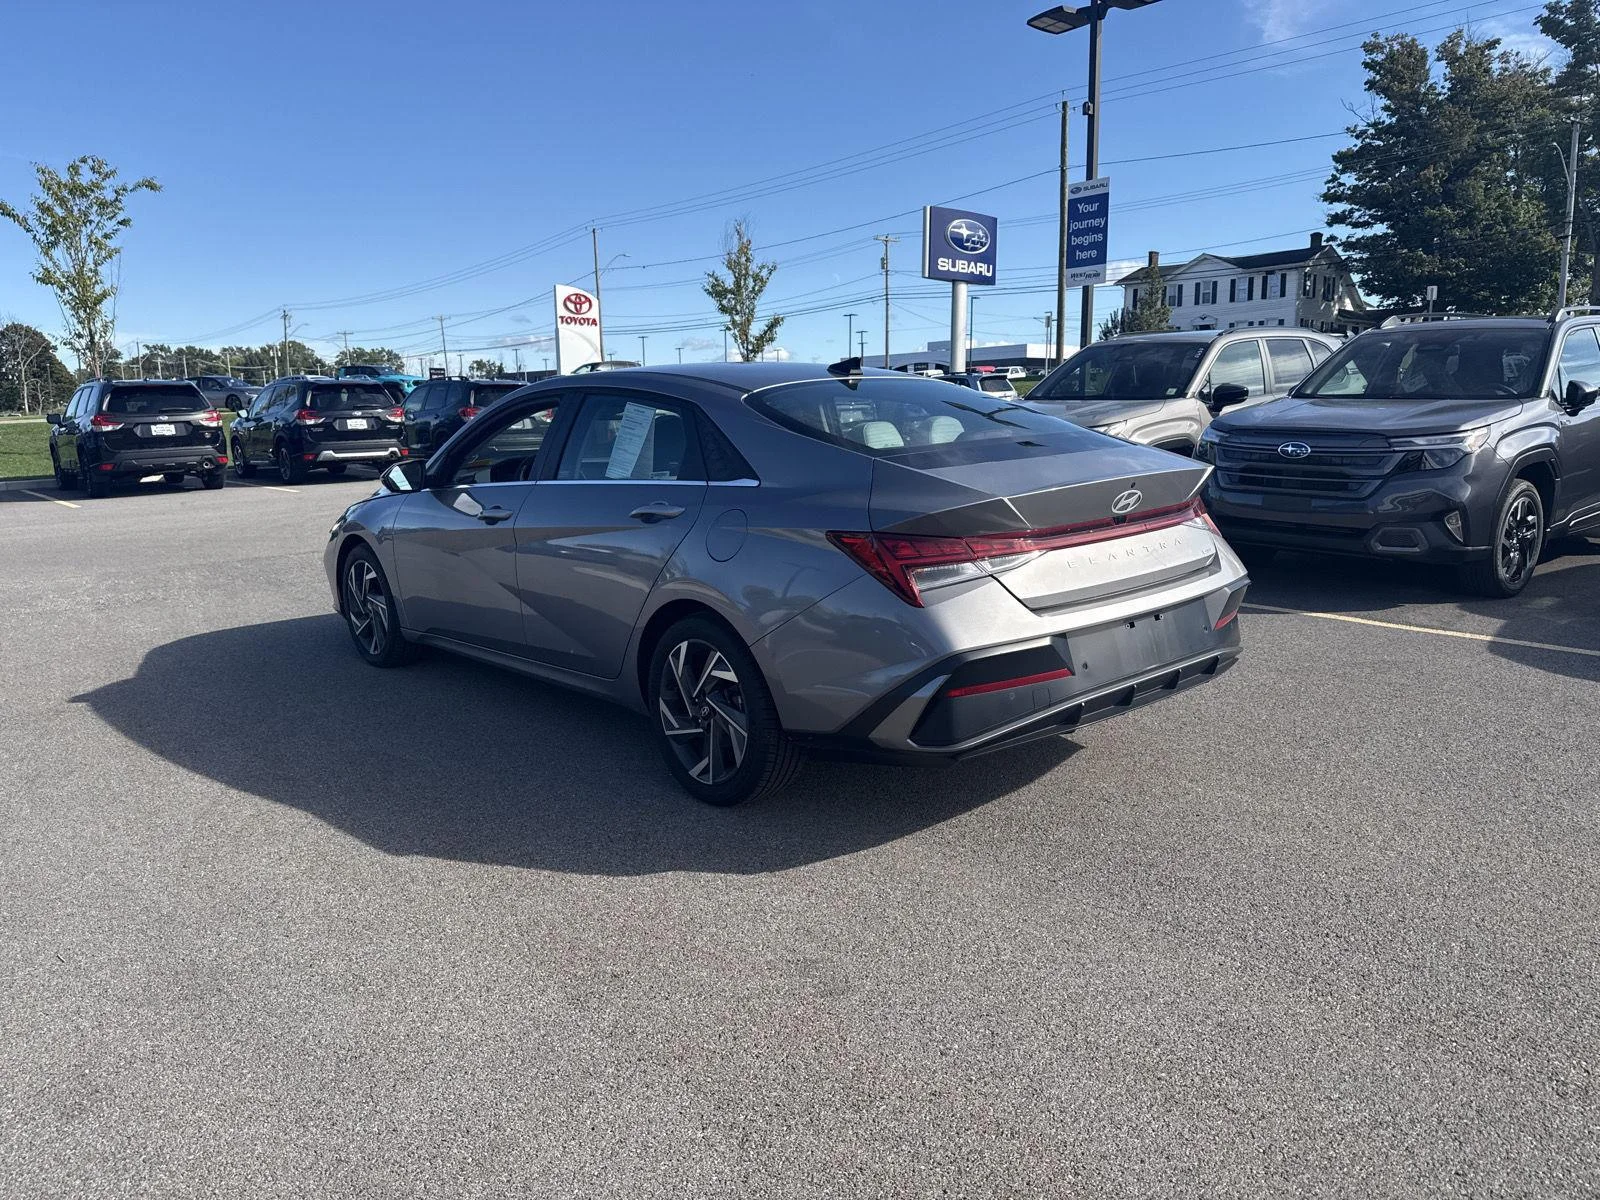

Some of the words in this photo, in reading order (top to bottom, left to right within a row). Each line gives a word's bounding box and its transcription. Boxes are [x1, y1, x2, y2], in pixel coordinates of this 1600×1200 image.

[1083, 182, 1108, 192] SUBARU
[1077, 202, 1099, 214] Your
[1069, 217, 1106, 232] journey
[1071, 233, 1103, 246] begins
[1076, 249, 1097, 260] here
[937, 257, 993, 277] SUBARU
[558, 315, 598, 327] TOYOTA
[1066, 537, 1184, 569] ELANTRA
